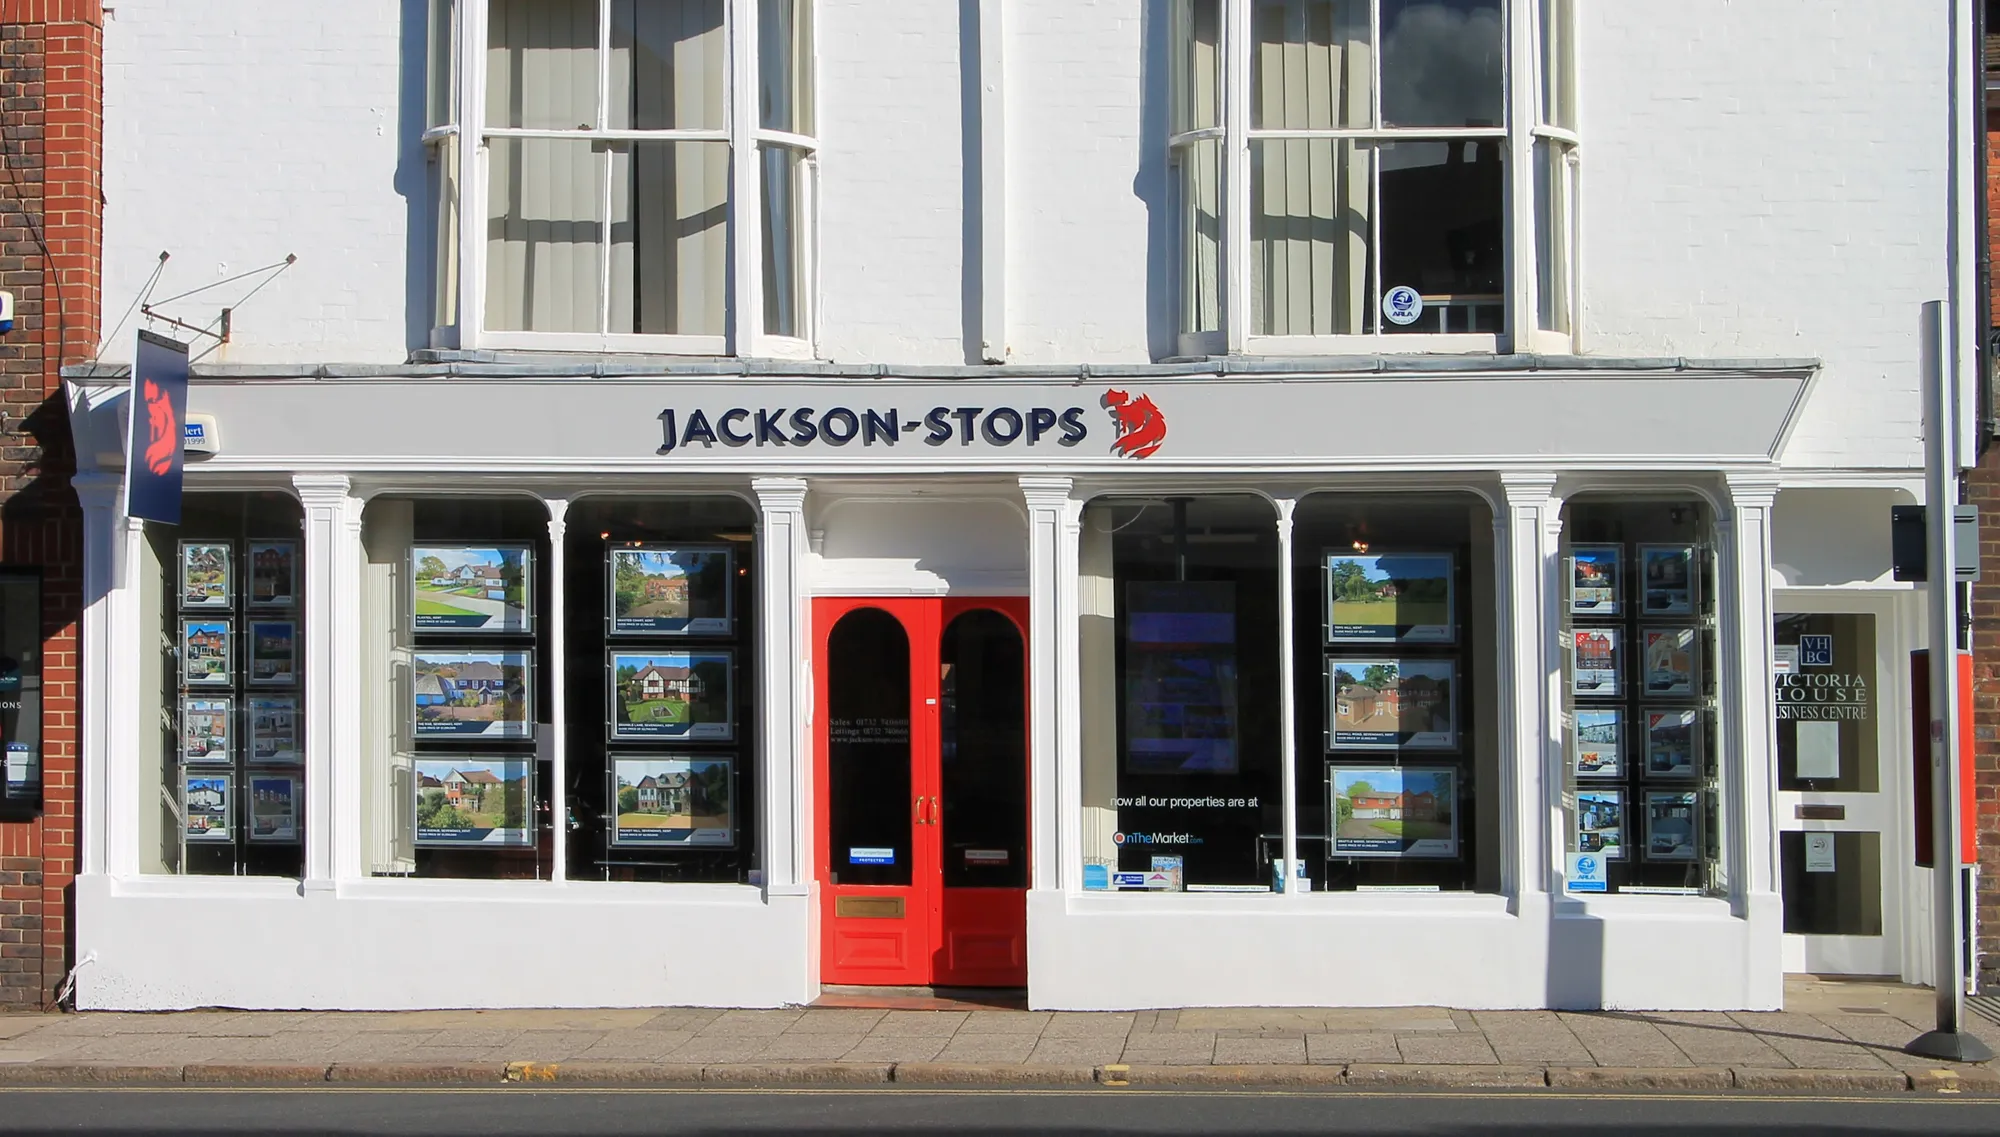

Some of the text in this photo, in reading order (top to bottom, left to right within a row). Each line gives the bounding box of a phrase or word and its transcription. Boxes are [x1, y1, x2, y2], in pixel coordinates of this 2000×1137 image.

[657, 407, 1087, 455] JACKSON-STOPS
[1806, 650, 1827, 662] BC
[1776, 706, 1867, 720] USINESS CENTRE
[1110, 796, 1258, 808] now all our properties are at
